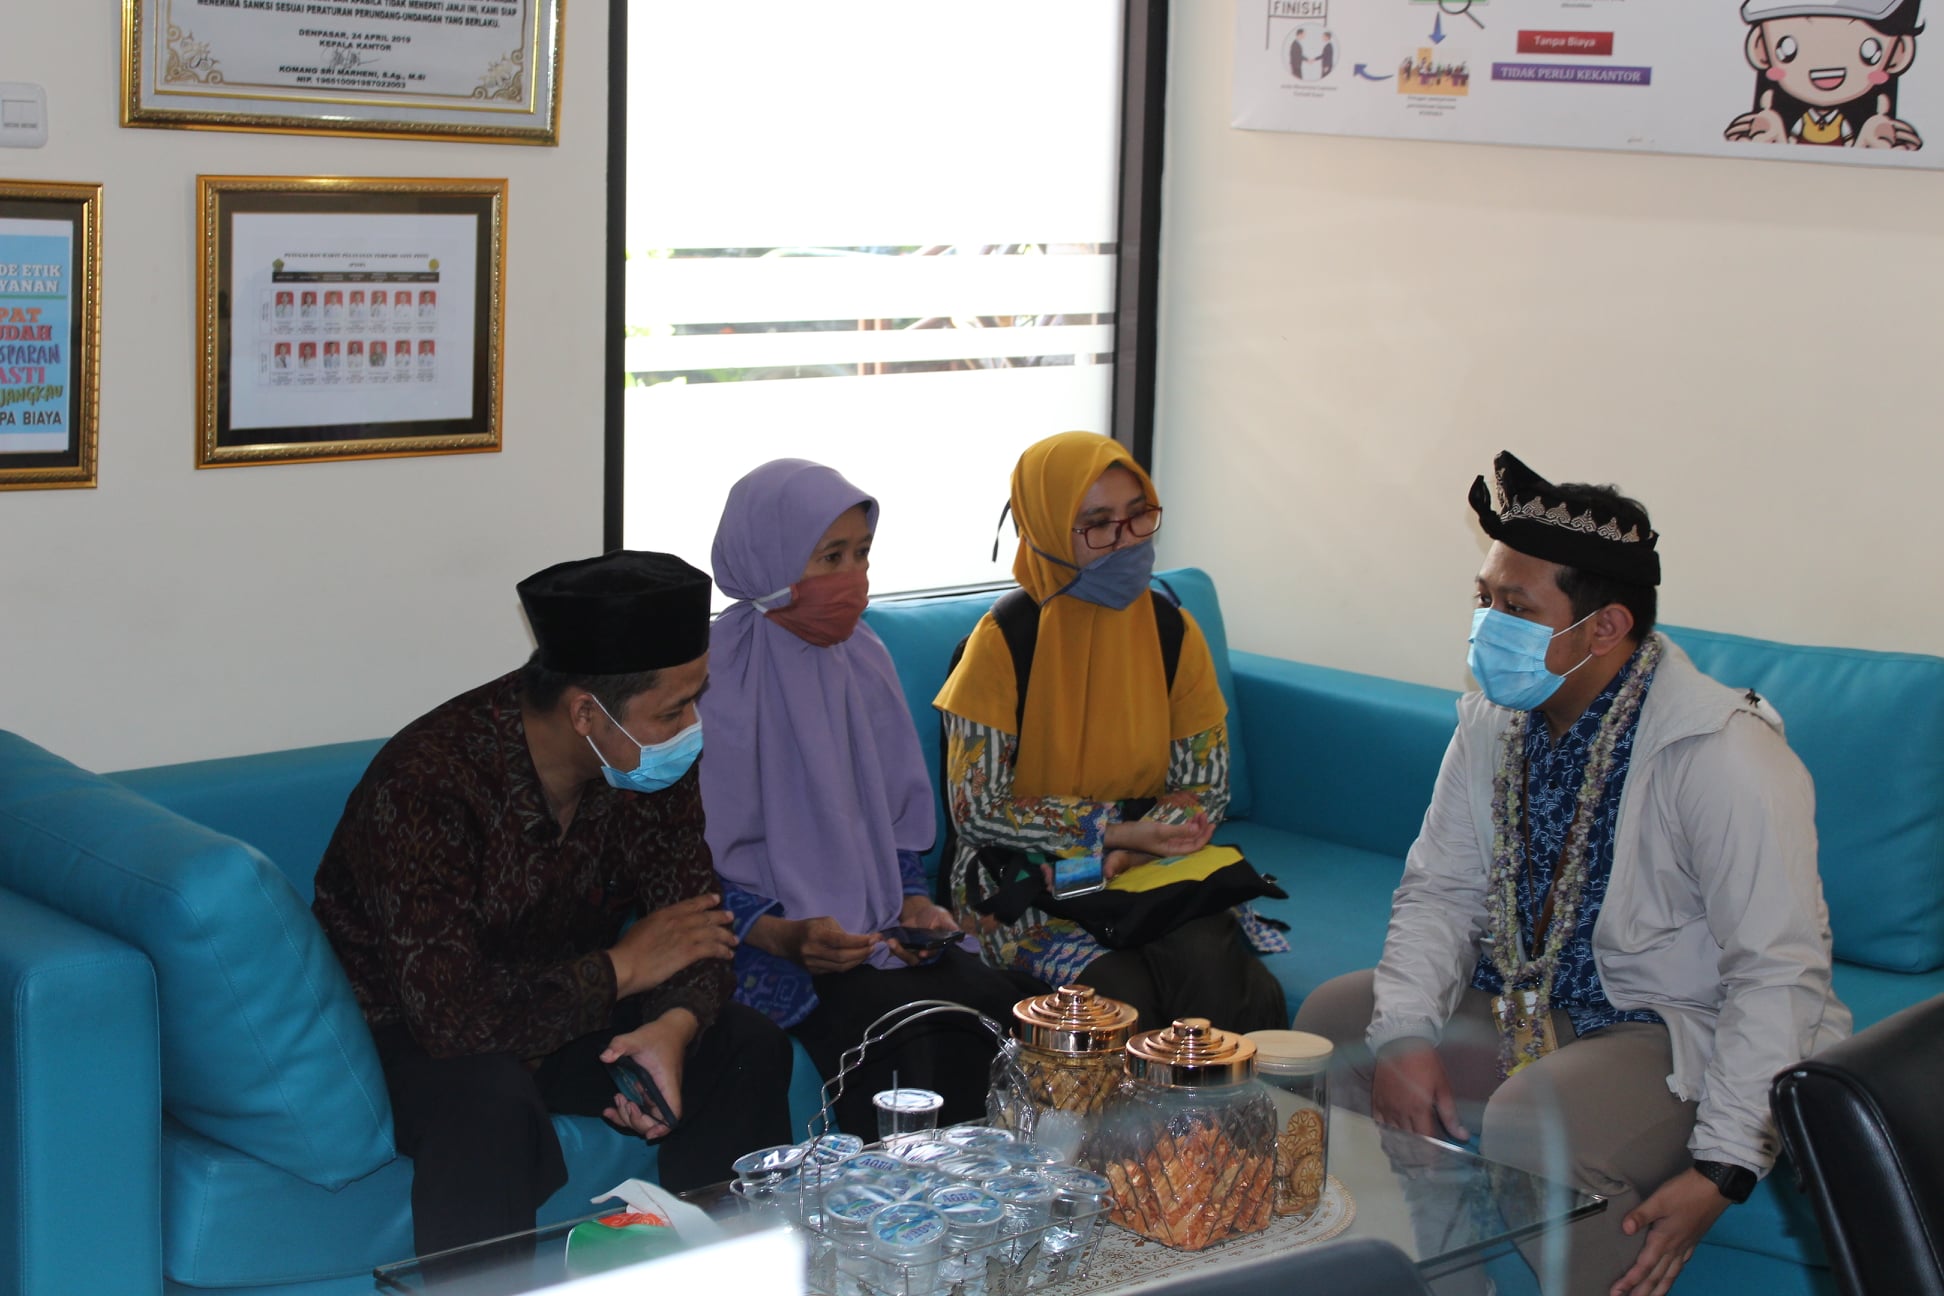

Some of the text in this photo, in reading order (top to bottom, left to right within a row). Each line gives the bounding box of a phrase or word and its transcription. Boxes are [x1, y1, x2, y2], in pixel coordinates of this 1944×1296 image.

[243, 1, 273, 11] SANKSI
[275, 3, 305, 13] SESUAI
[306, 5, 353, 17] PERATURAN
[355, 8, 442, 24] PERUNDANG-UNDANGAN
[444, 15, 463, 25] YANG
[1273, 0, 1323, 15] FINISH
[299, 29, 412, 44] DENPASAR, 24 APRIL 2019
[1534, 35, 1597, 49] Tanpa Biaya
[319, 40, 392, 52] KEPALA KANTOR
[279, 65, 318, 75] KOMANG
[320, 67, 335, 76] SRI
[337, 68, 380, 80] MARHENI,
[1501, 66, 1642, 83] TIDAK PERLU KEKANTOR
[22, 264, 63, 278] ETIK
[0, 307, 43, 323] PAT
[23, 410, 62, 425] BIAYA
[859, 1157, 895, 1172] AQUA
[942, 1191, 979, 1203] AQUA
